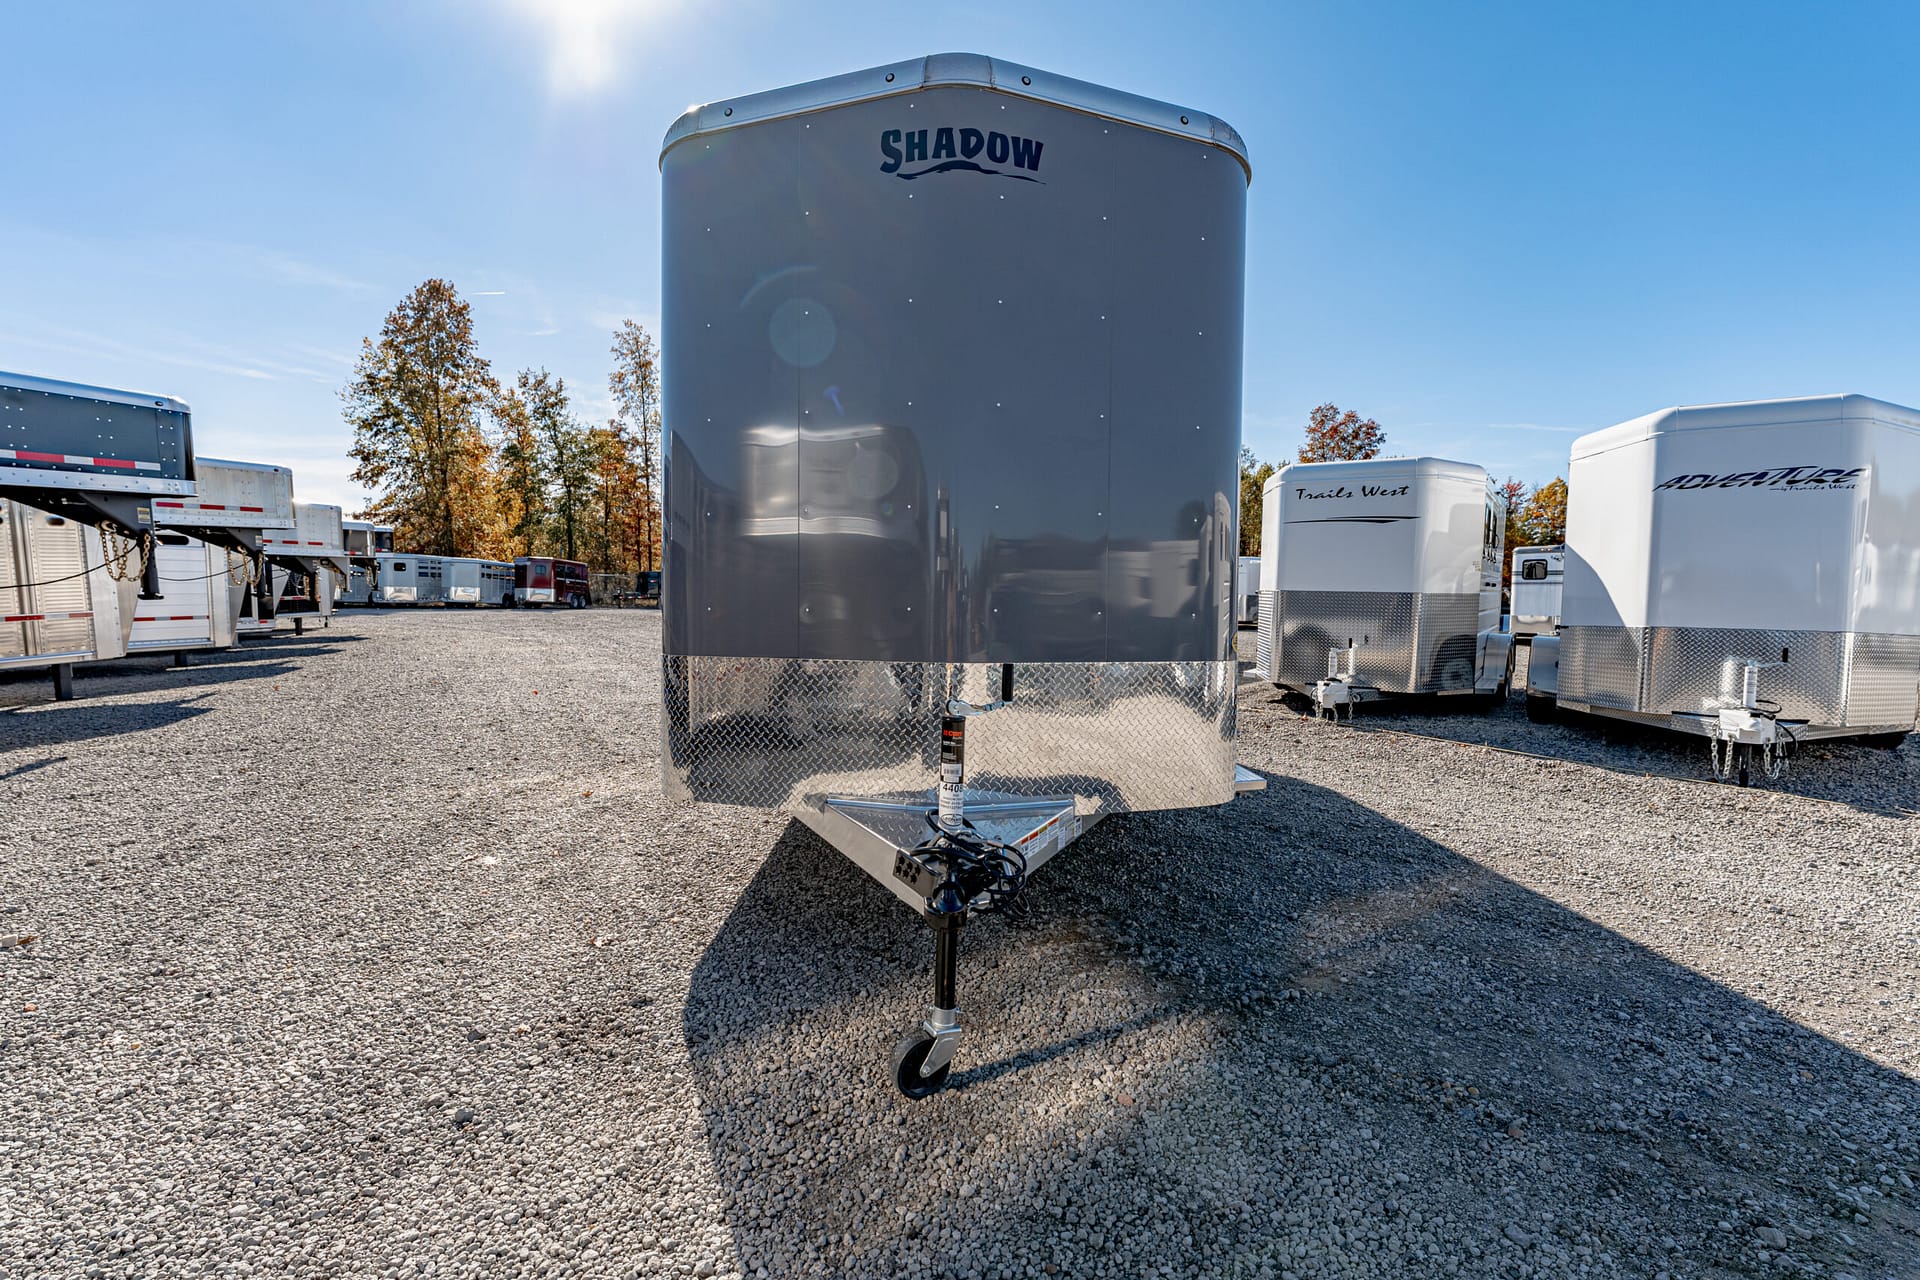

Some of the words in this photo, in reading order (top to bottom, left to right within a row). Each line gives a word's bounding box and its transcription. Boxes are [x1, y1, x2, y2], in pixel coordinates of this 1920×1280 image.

[880, 127, 1044, 173] SHADOW
[1652, 465, 1866, 492] ADVENTURE
[1296, 487, 1354, 500] Trails
[1361, 485, 1409, 497] West
